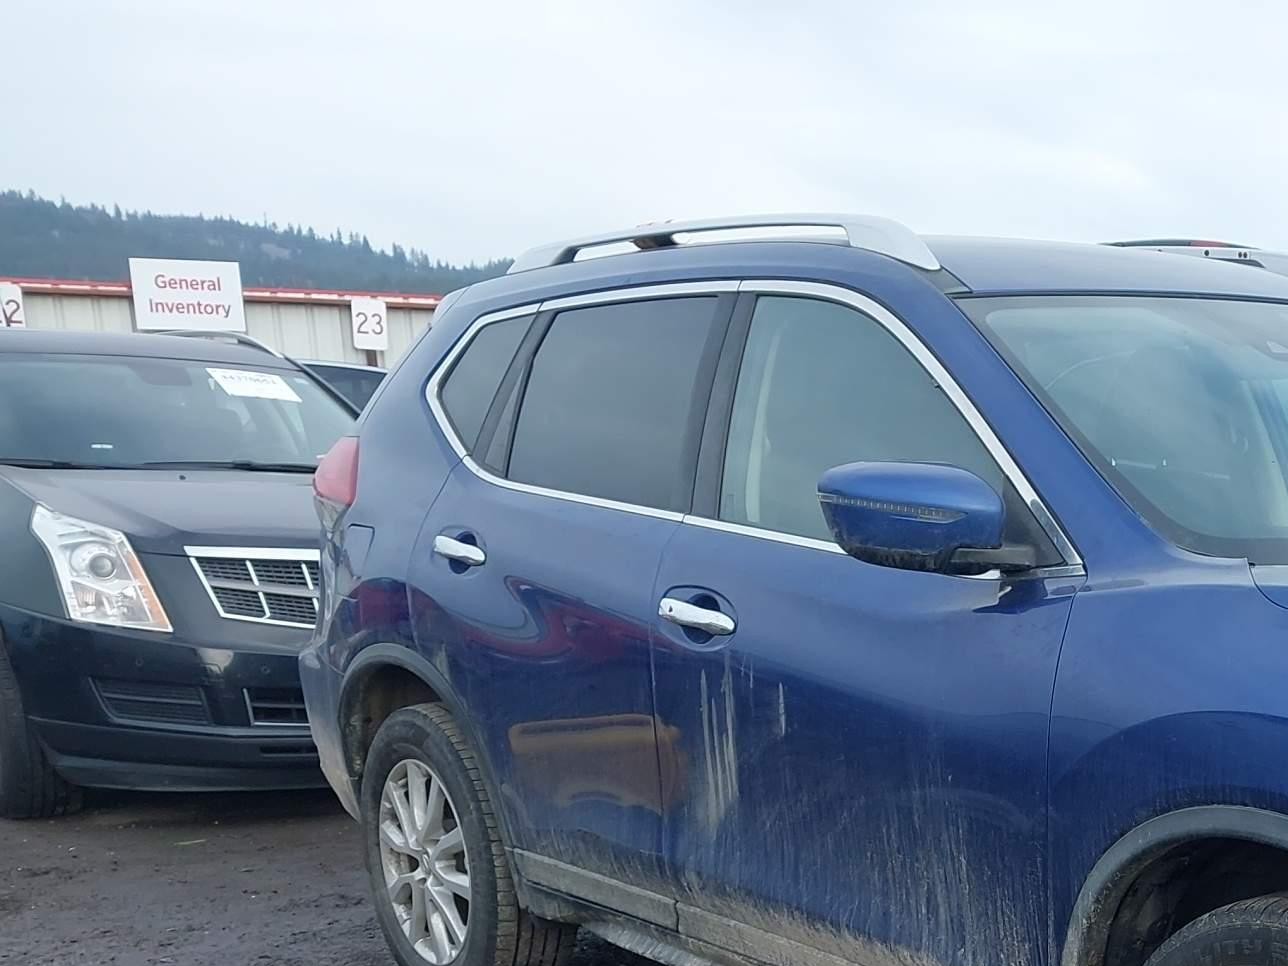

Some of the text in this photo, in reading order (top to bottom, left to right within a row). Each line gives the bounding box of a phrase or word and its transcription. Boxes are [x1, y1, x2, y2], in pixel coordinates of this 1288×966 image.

[153, 274, 222, 292] General
[149, 298, 231, 318] Inventory
[355, 311, 384, 335] 23
